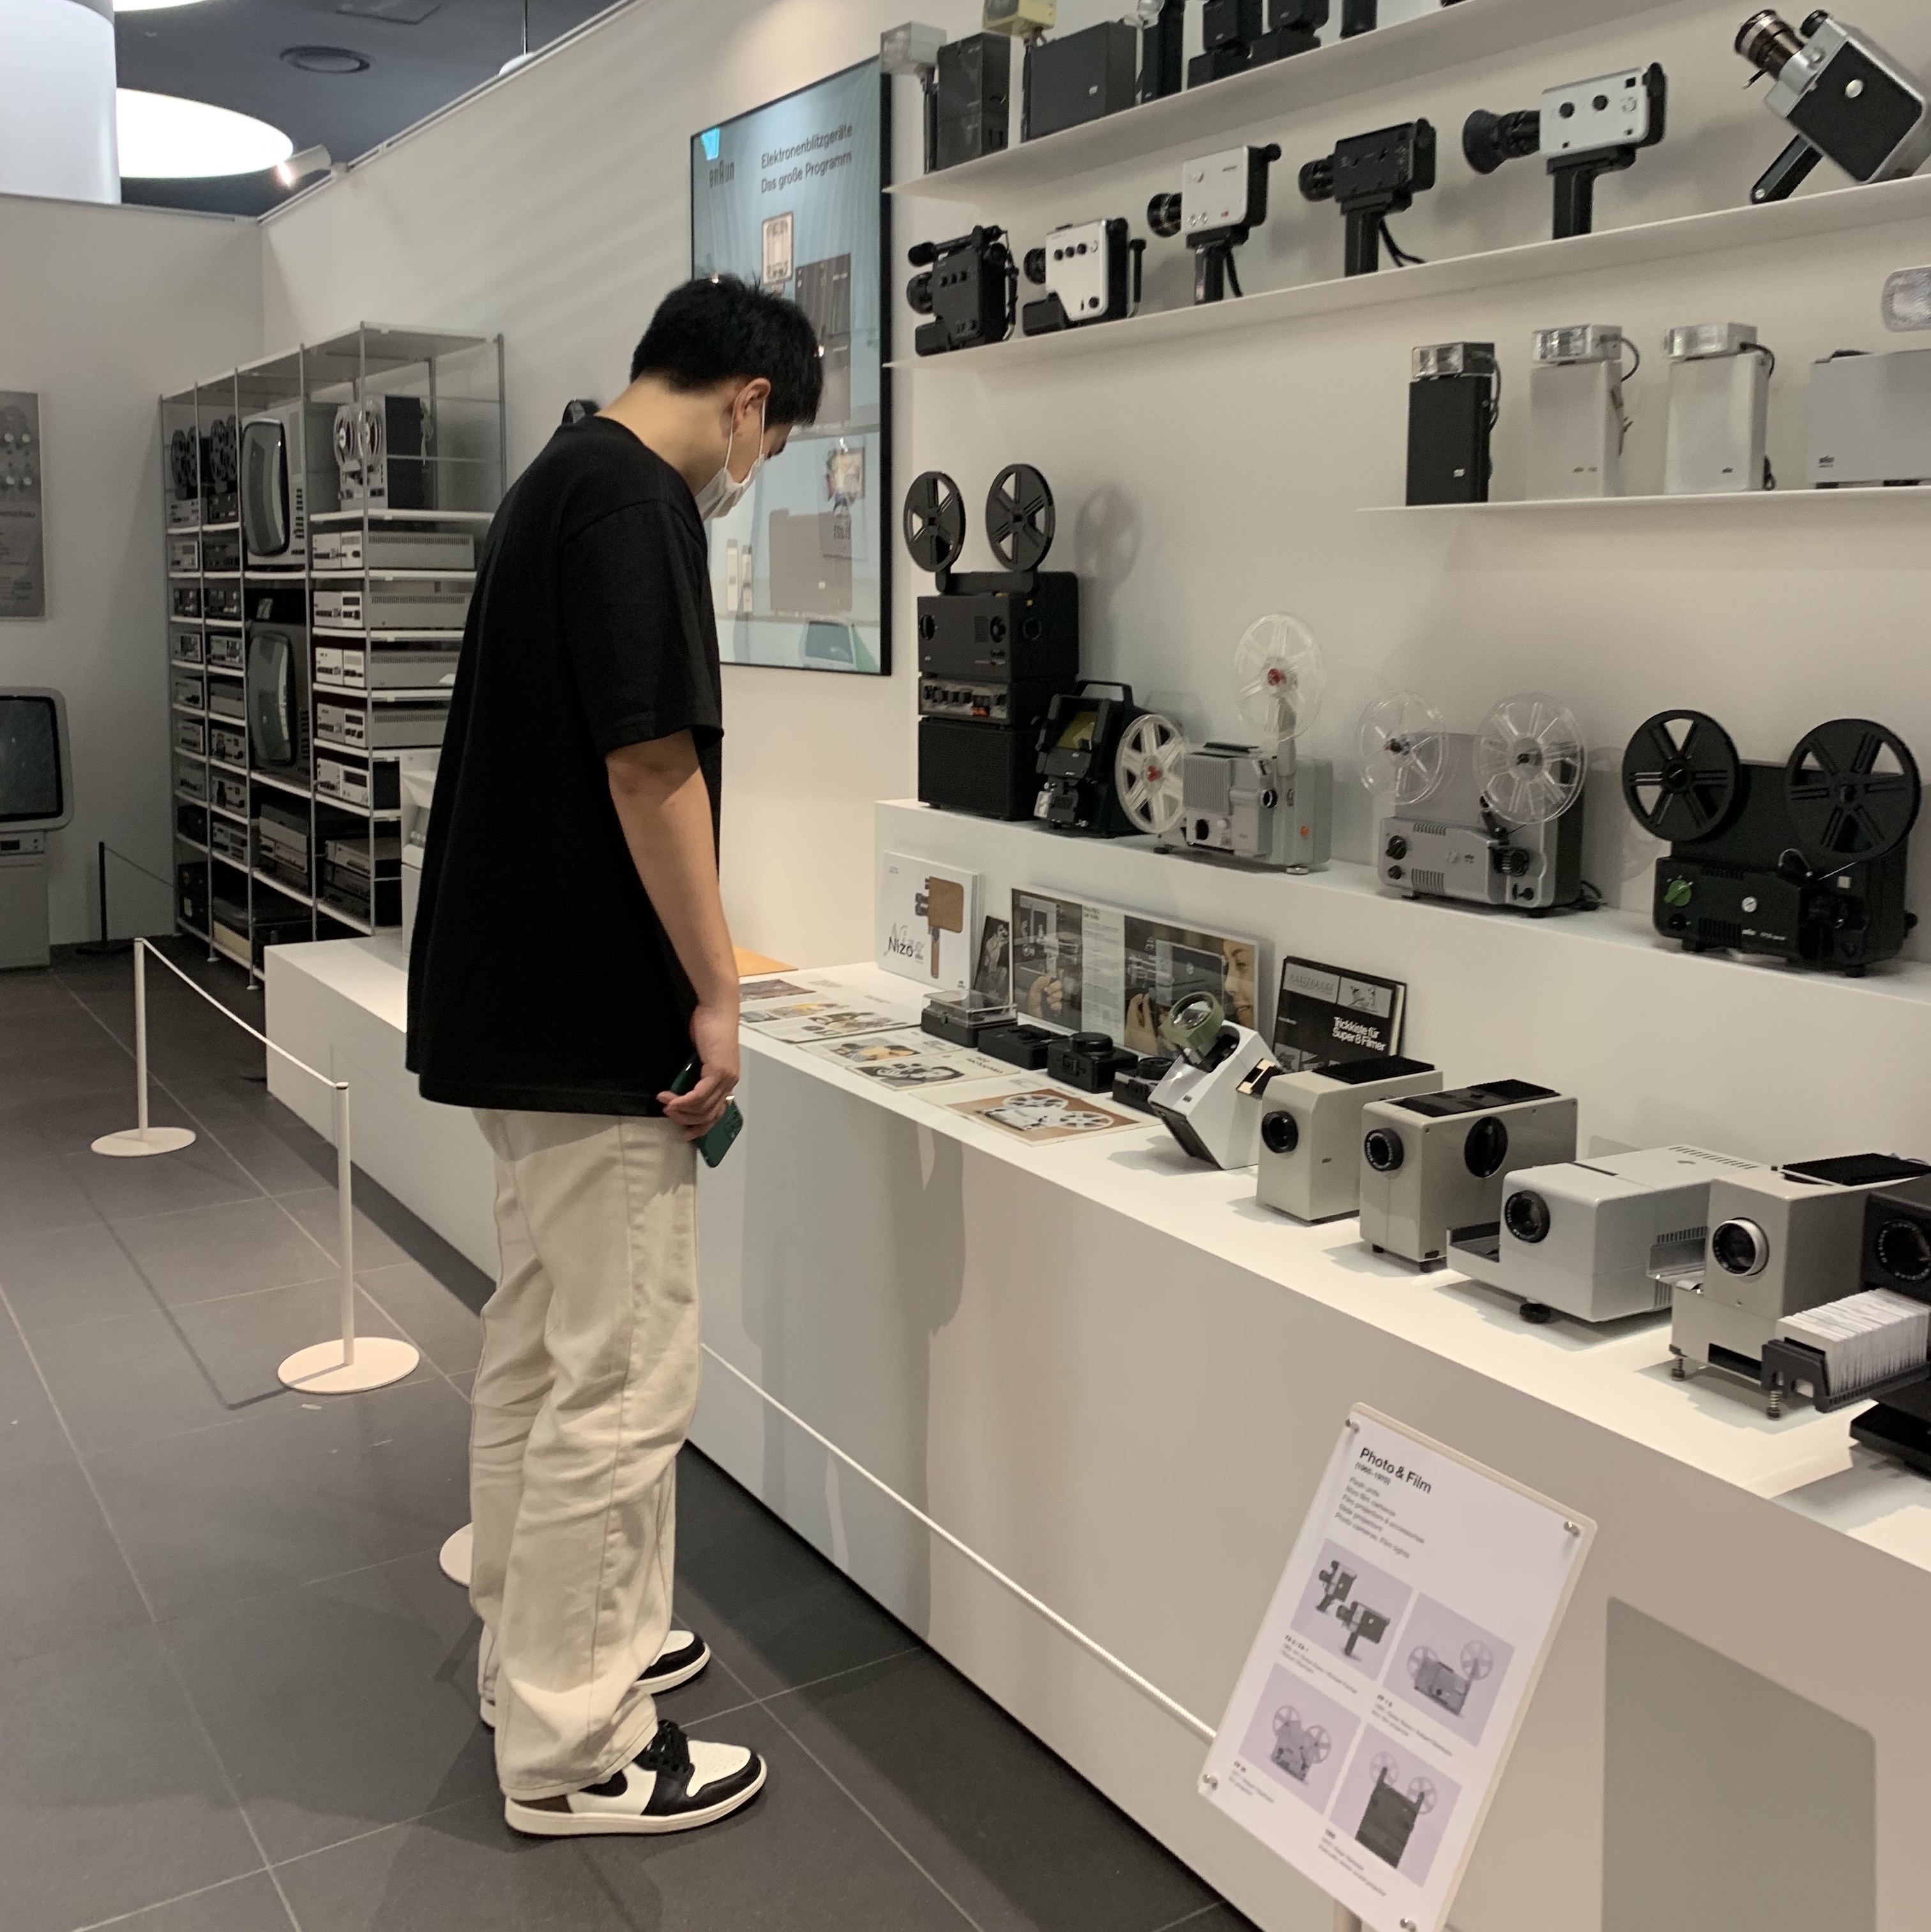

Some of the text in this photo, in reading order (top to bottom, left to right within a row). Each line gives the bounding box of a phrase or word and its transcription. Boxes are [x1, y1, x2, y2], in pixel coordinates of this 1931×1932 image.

[761, 123, 852, 169] Elektronenblitzgeräte
[761, 152, 852, 194] Das große Programm
[888, 936, 914, 957] Nizo
[1332, 1026, 1355, 1042] Super
[1354, 1033, 1361, 1044] 8
[1360, 1447, 1432, 1492] Photo & Film
